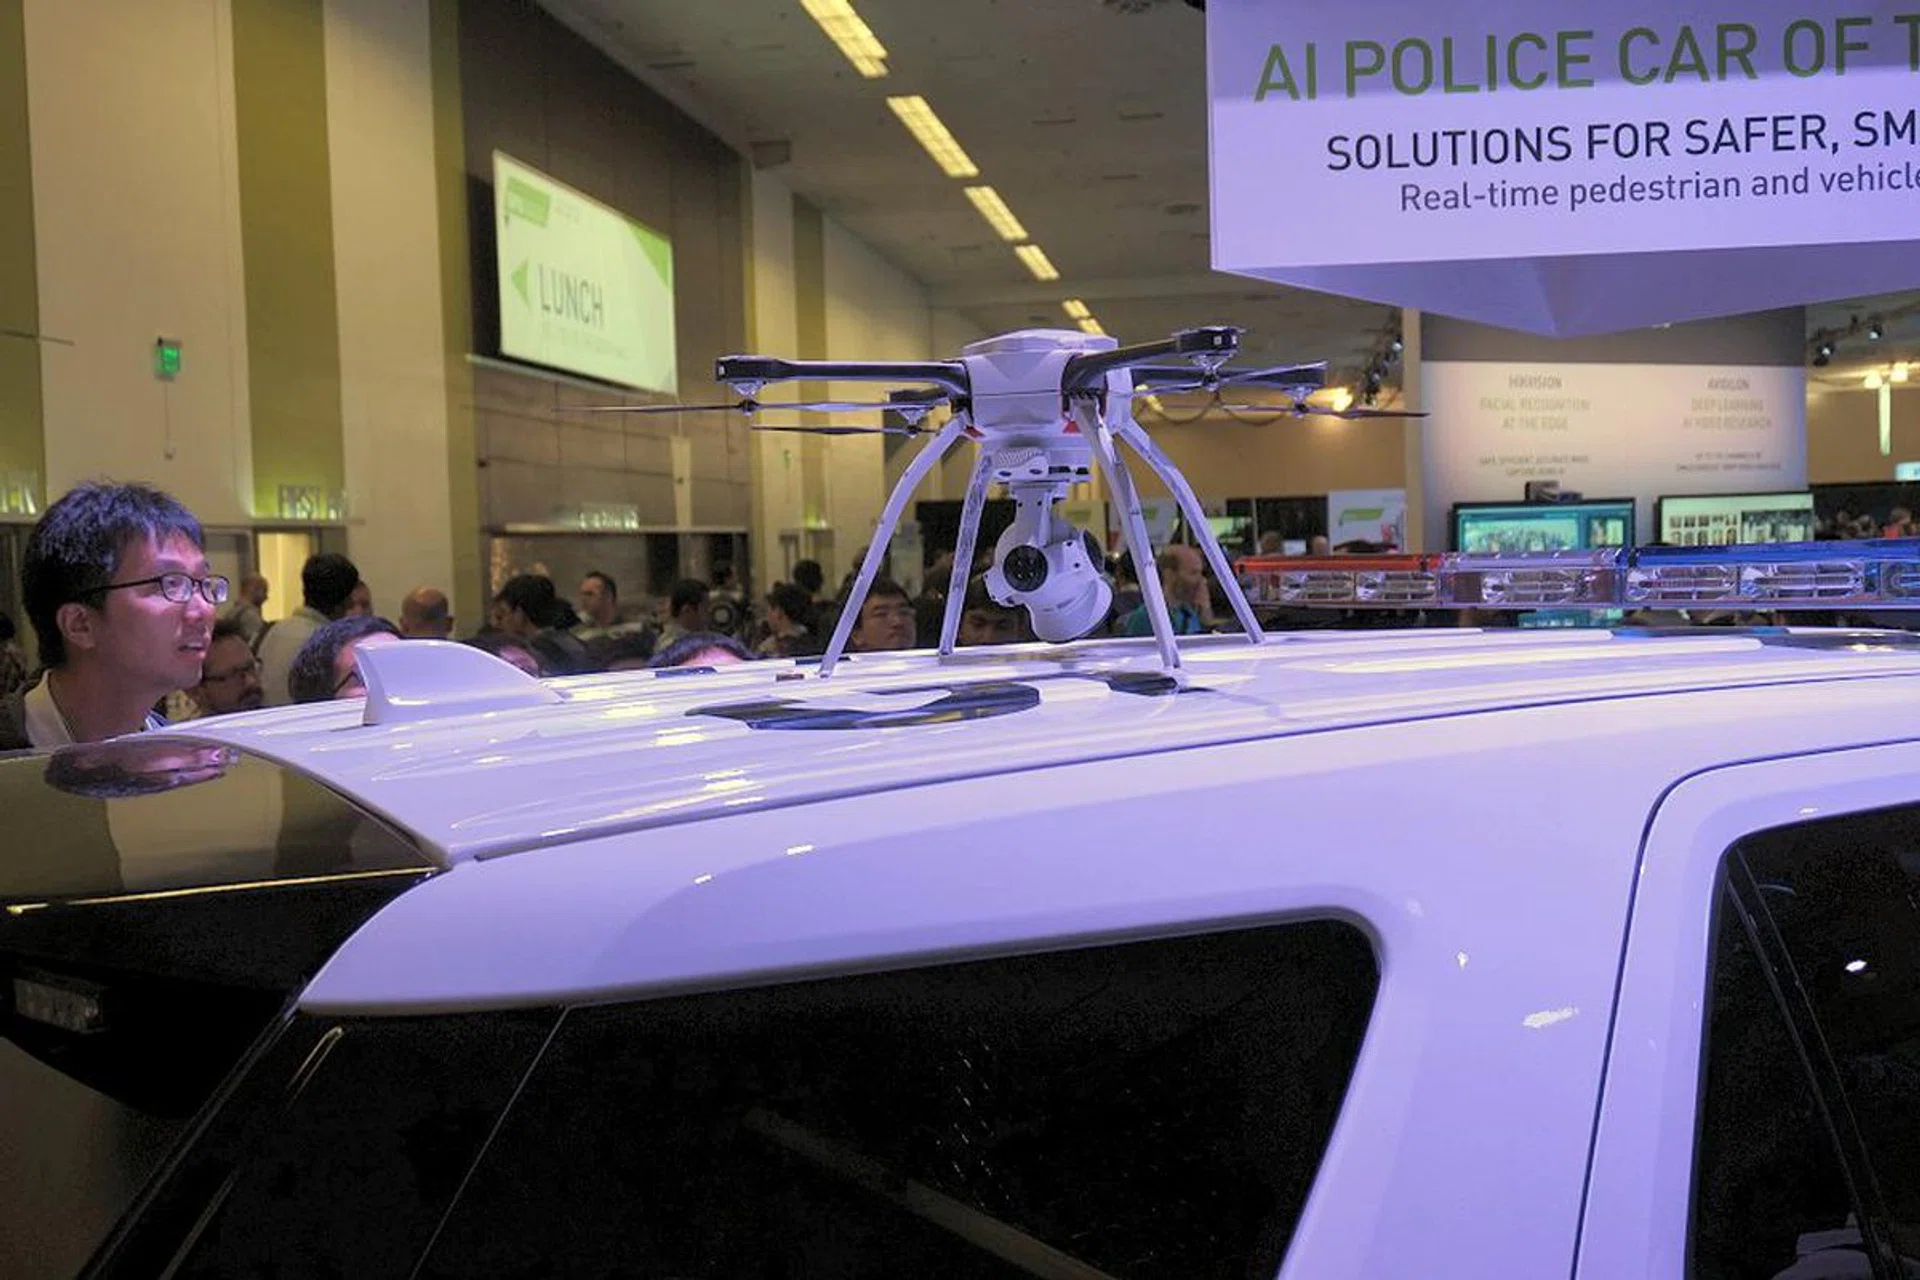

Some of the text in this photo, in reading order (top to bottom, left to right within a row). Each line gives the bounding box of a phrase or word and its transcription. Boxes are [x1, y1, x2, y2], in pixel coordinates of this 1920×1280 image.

[1255, 42, 1317, 101] AI
[1345, 30, 1594, 98] POLICE
[1618, 25, 1758, 86] CAR
[1783, 16, 1873, 77] OF
[1326, 108, 1920, 171] SOLUTIONS FOR SAFER, SM
[1401, 180, 1559, 212] Real-time
[1570, 171, 1741, 212] pedestrian
[1752, 166, 1809, 197] and
[538, 263, 604, 327] LUNCH
